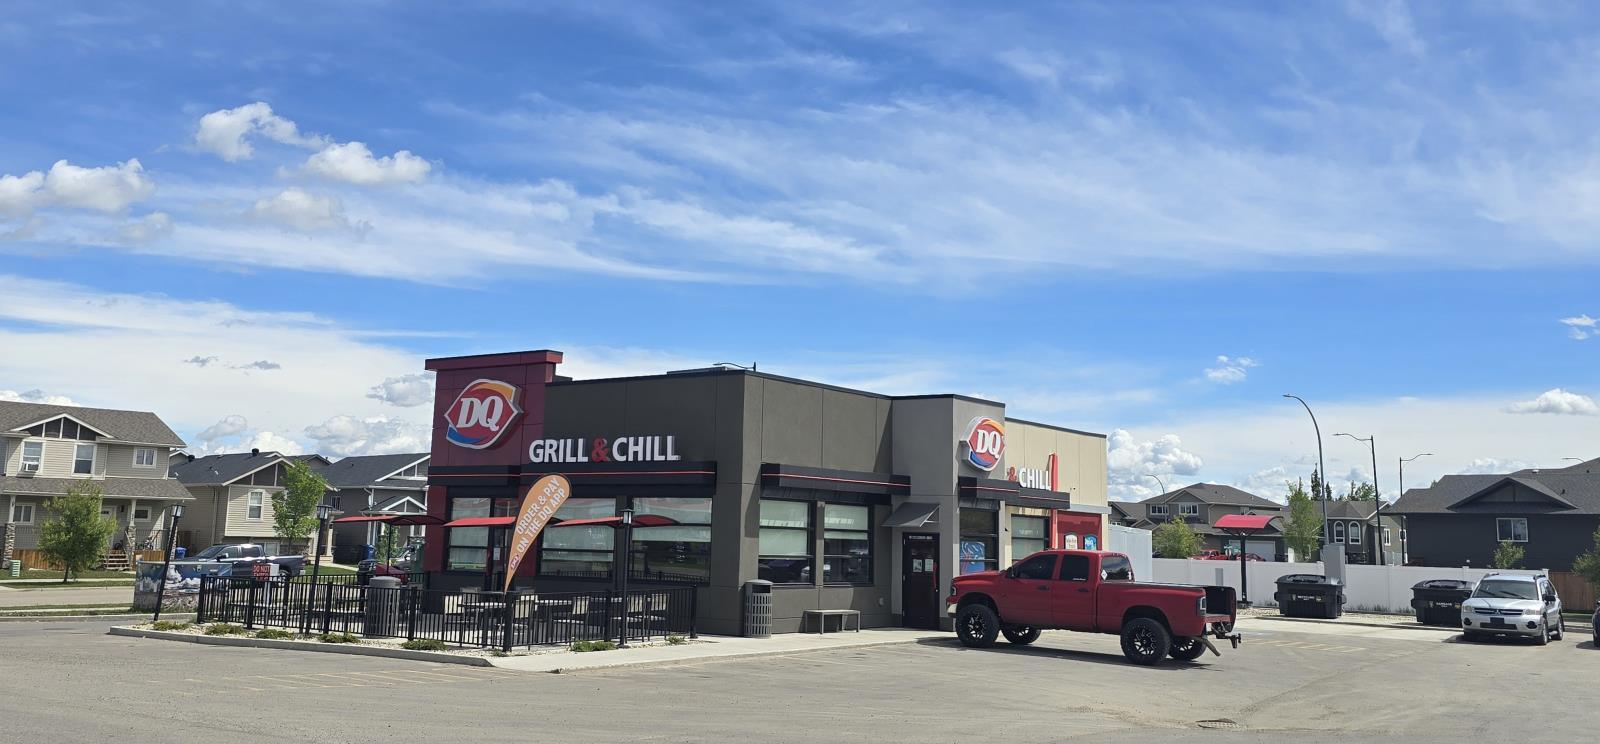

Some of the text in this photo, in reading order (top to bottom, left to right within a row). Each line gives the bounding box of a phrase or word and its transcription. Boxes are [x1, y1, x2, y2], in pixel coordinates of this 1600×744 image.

[456, 396, 503, 431] DQ
[528, 435, 678, 463] GRILL & CHILL
[975, 429, 1001, 459] DQ
[1007, 466, 1052, 492] & CHILL
[516, 477, 560, 535] ORDER & PAY
[516, 487, 566, 553] ON THE DQ APP
[253, 565, 270, 573] DO NOT
